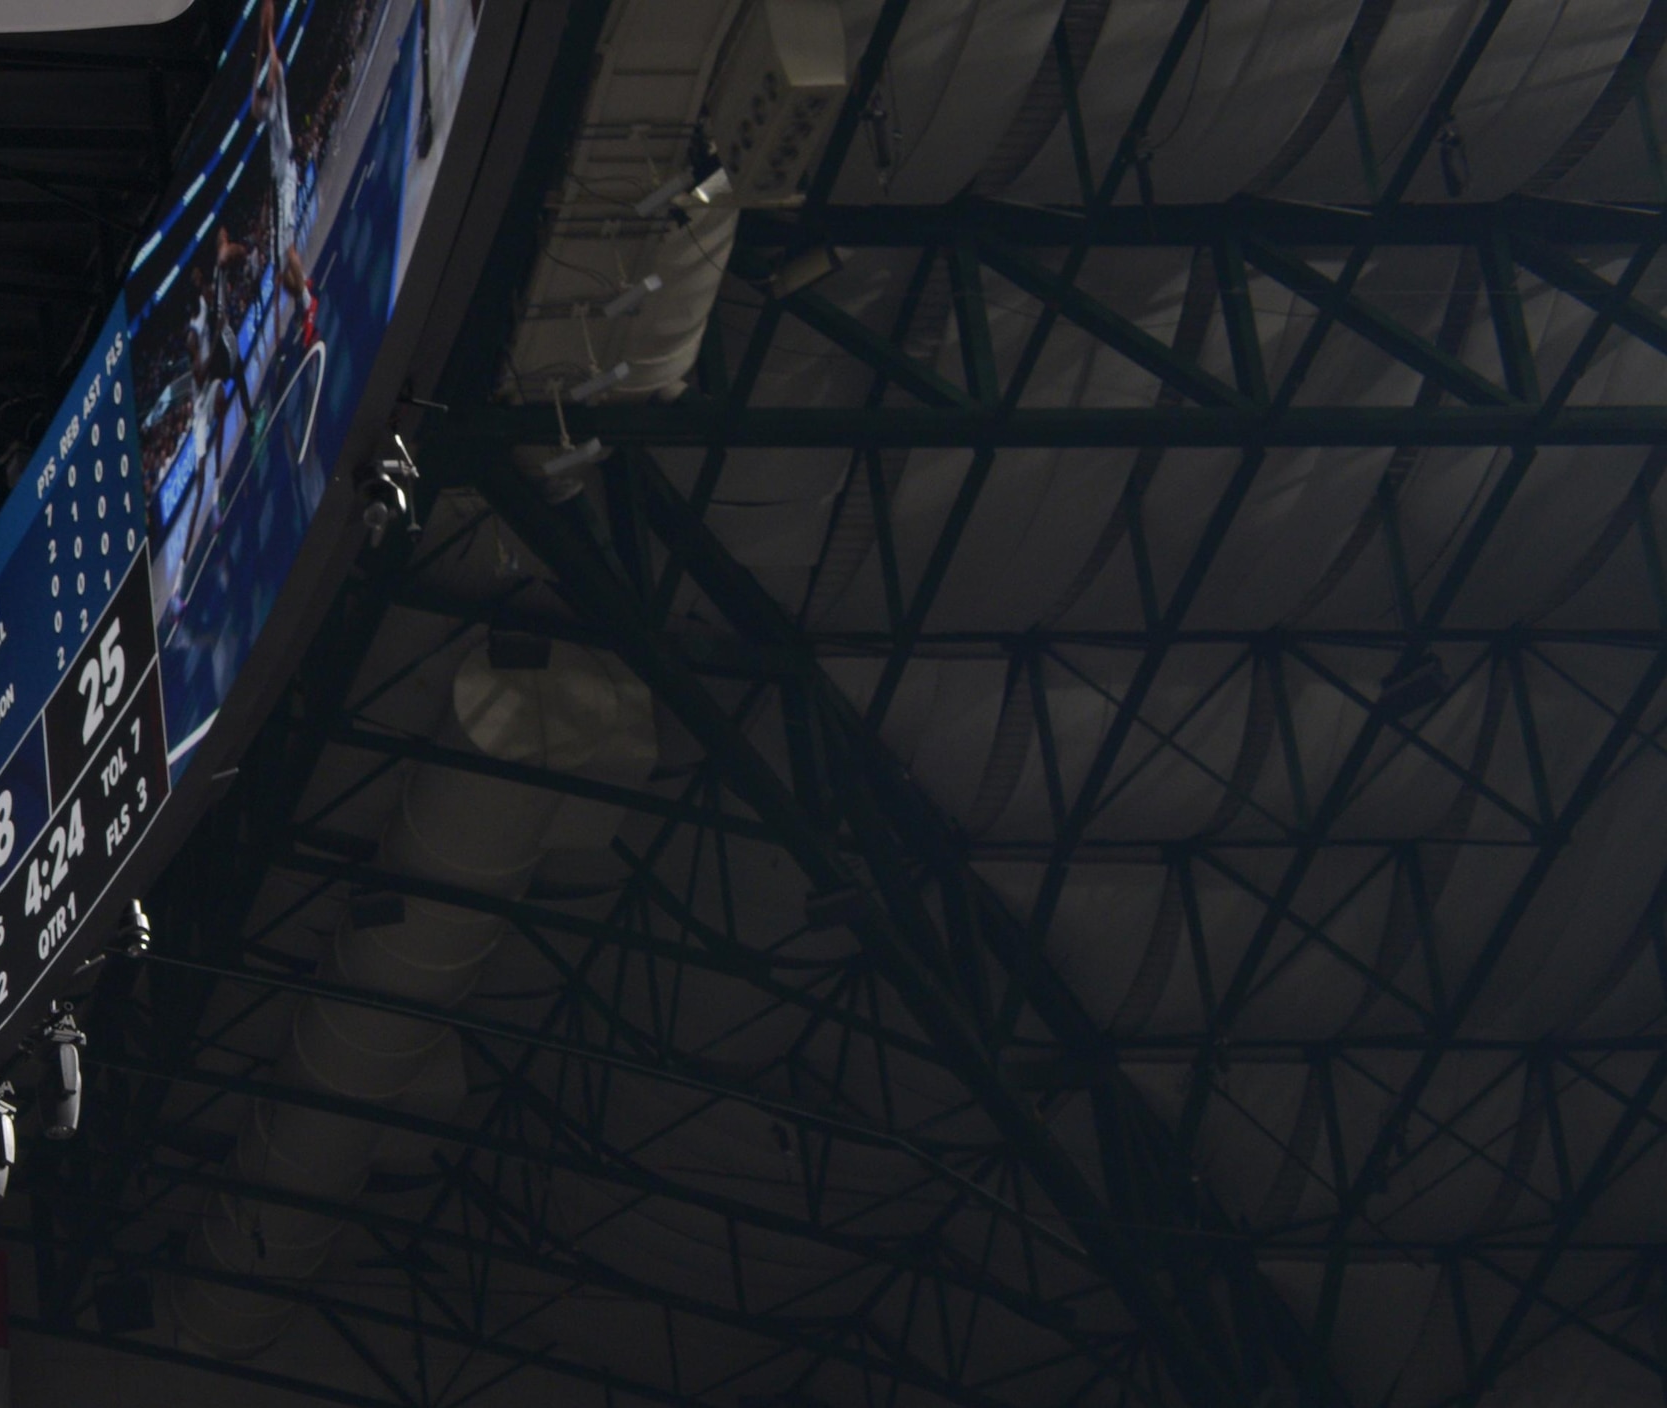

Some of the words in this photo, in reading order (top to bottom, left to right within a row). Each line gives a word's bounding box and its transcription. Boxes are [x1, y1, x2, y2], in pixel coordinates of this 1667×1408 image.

[37, 456, 56, 499] PTS
[83, 374, 101, 419] AST
[105, 332, 124, 375] FLS
[78, 618, 126, 745] 25
[100, 755, 126, 797] TOL
[131, 717, 141, 746] 7
[25, 799, 85, 916] 4:24
[106, 810, 130, 856] FLS
[137, 777, 148, 811] 3
